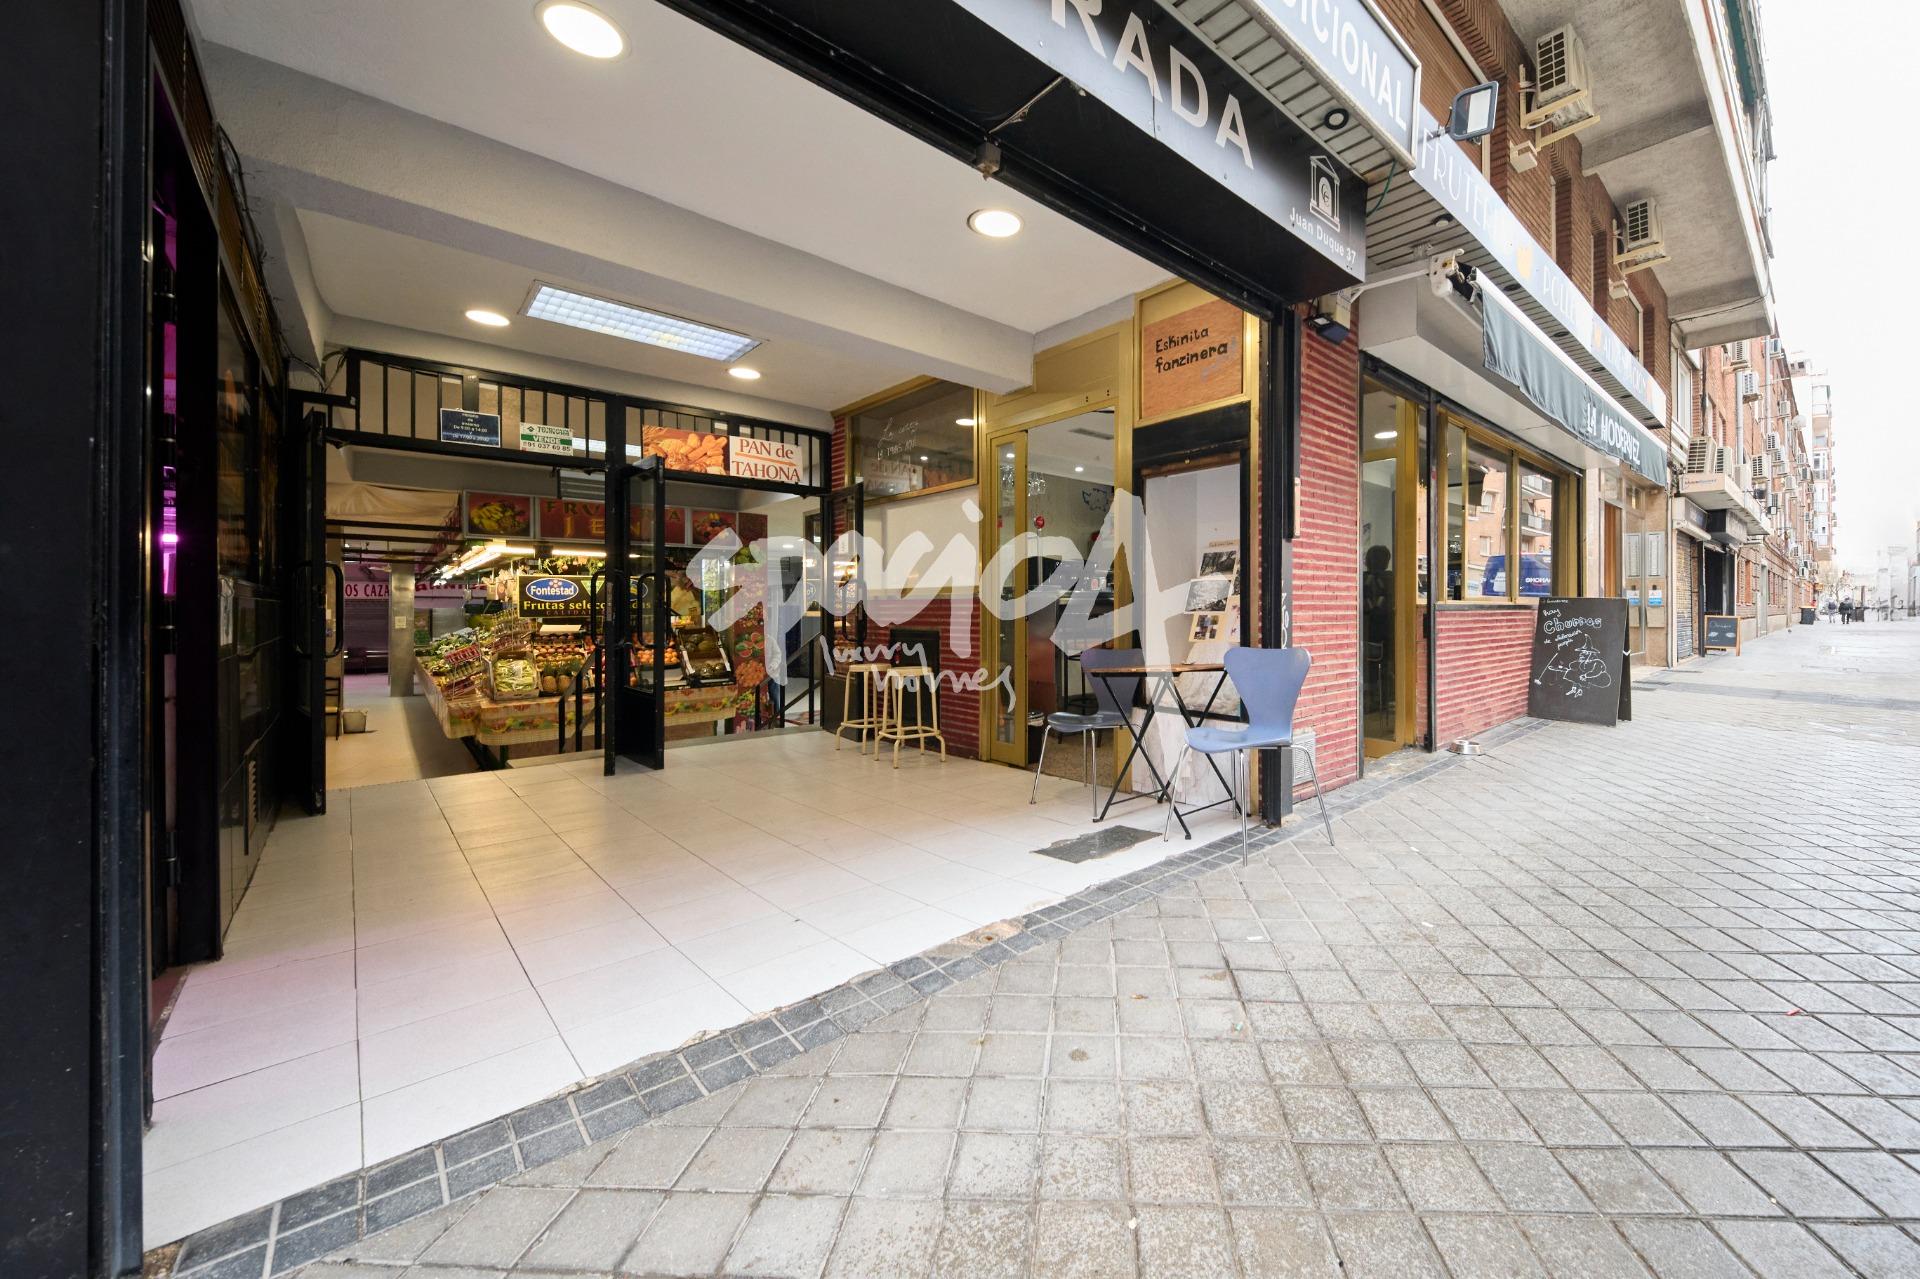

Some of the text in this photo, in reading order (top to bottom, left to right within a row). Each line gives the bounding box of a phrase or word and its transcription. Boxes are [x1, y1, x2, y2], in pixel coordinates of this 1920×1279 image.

[1283, 0, 1406, 131] CIONAL
[1289, 206, 1357, 265] Juan Duque 37
[1155, 326, 1209, 353] Eskinita
[1155, 341, 1229, 374] fanzinera
[533, 435, 560, 445] VENDE
[739, 438, 794, 460] PAN de
[731, 460, 800, 482] TAHONA
[530, 585, 575, 596] Fontestad
[523, 601, 564, 610] Frutas
[1543, 616, 1602, 634] Churros
